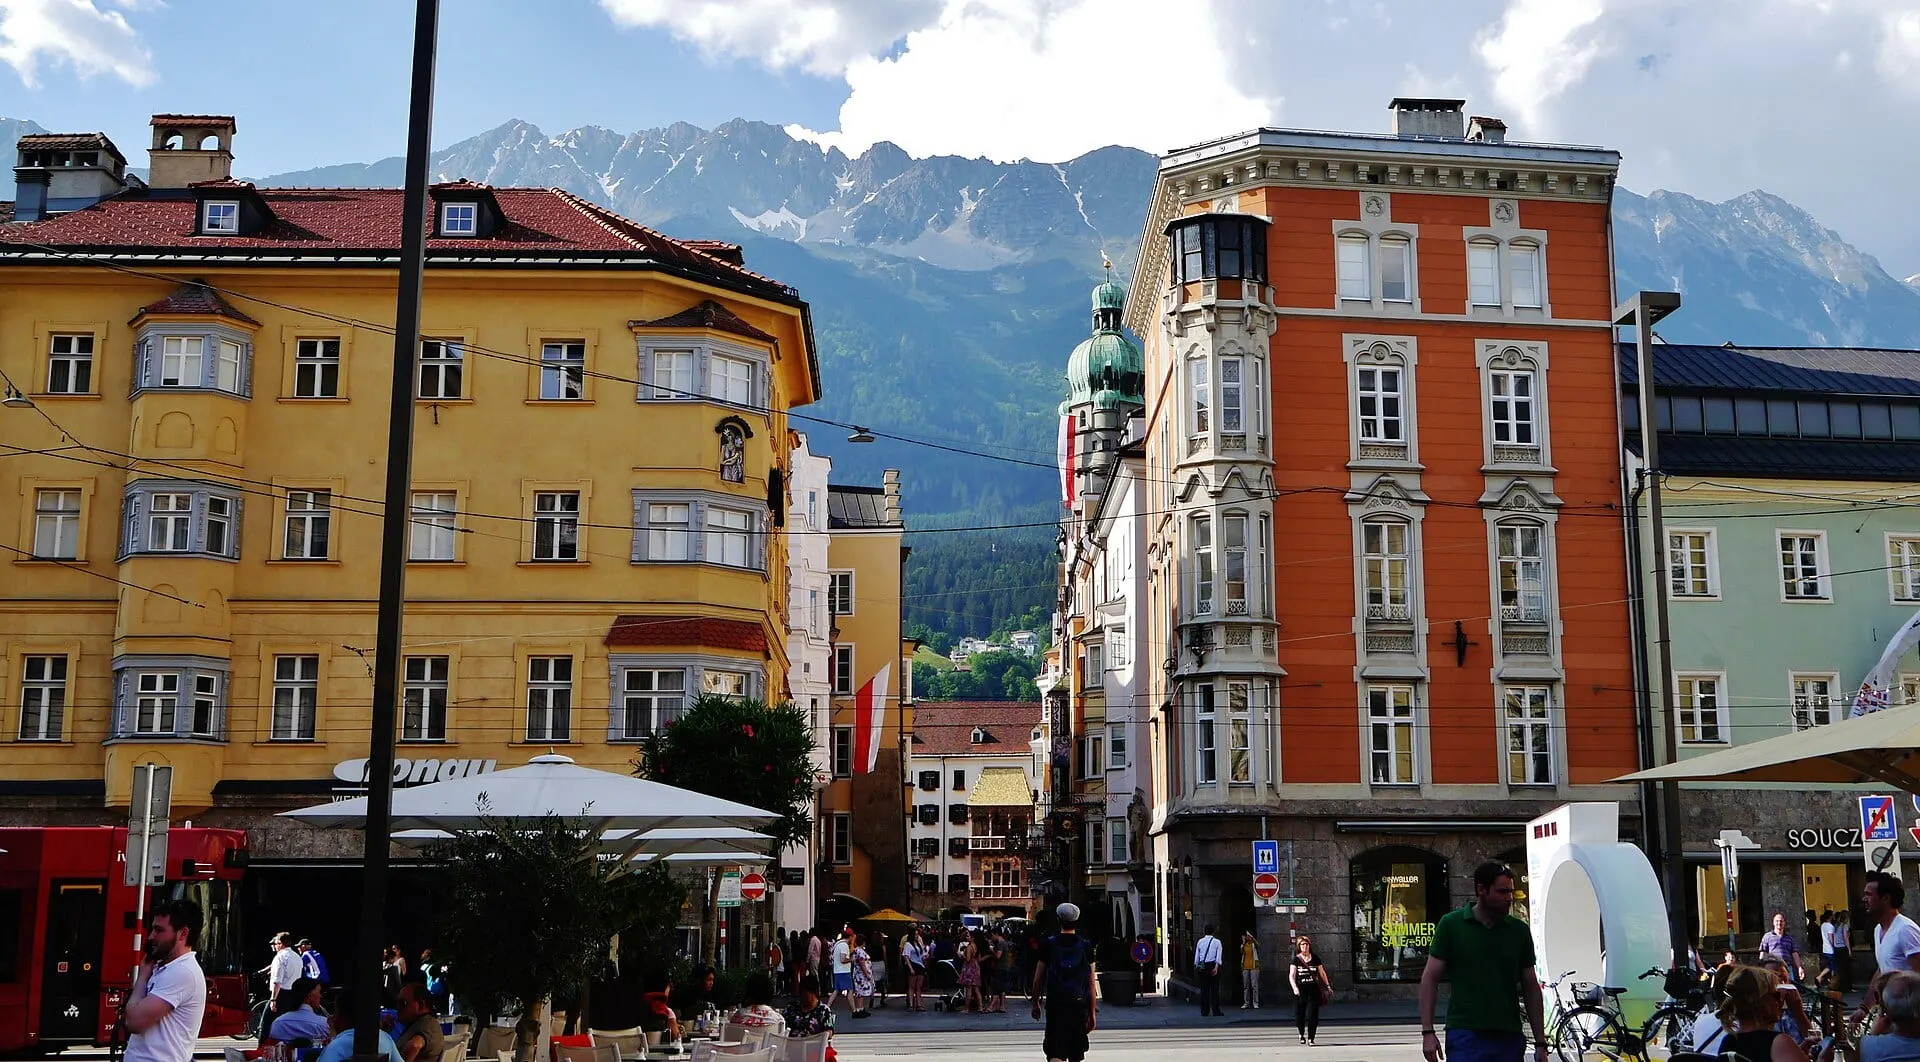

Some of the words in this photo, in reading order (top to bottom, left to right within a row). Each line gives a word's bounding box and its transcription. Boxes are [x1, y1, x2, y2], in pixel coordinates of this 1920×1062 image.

[1788, 829, 1863, 848] SOUCZ
[1381, 922, 1436, 936] SUMMER
[1382, 936, 1408, 947] SALE
